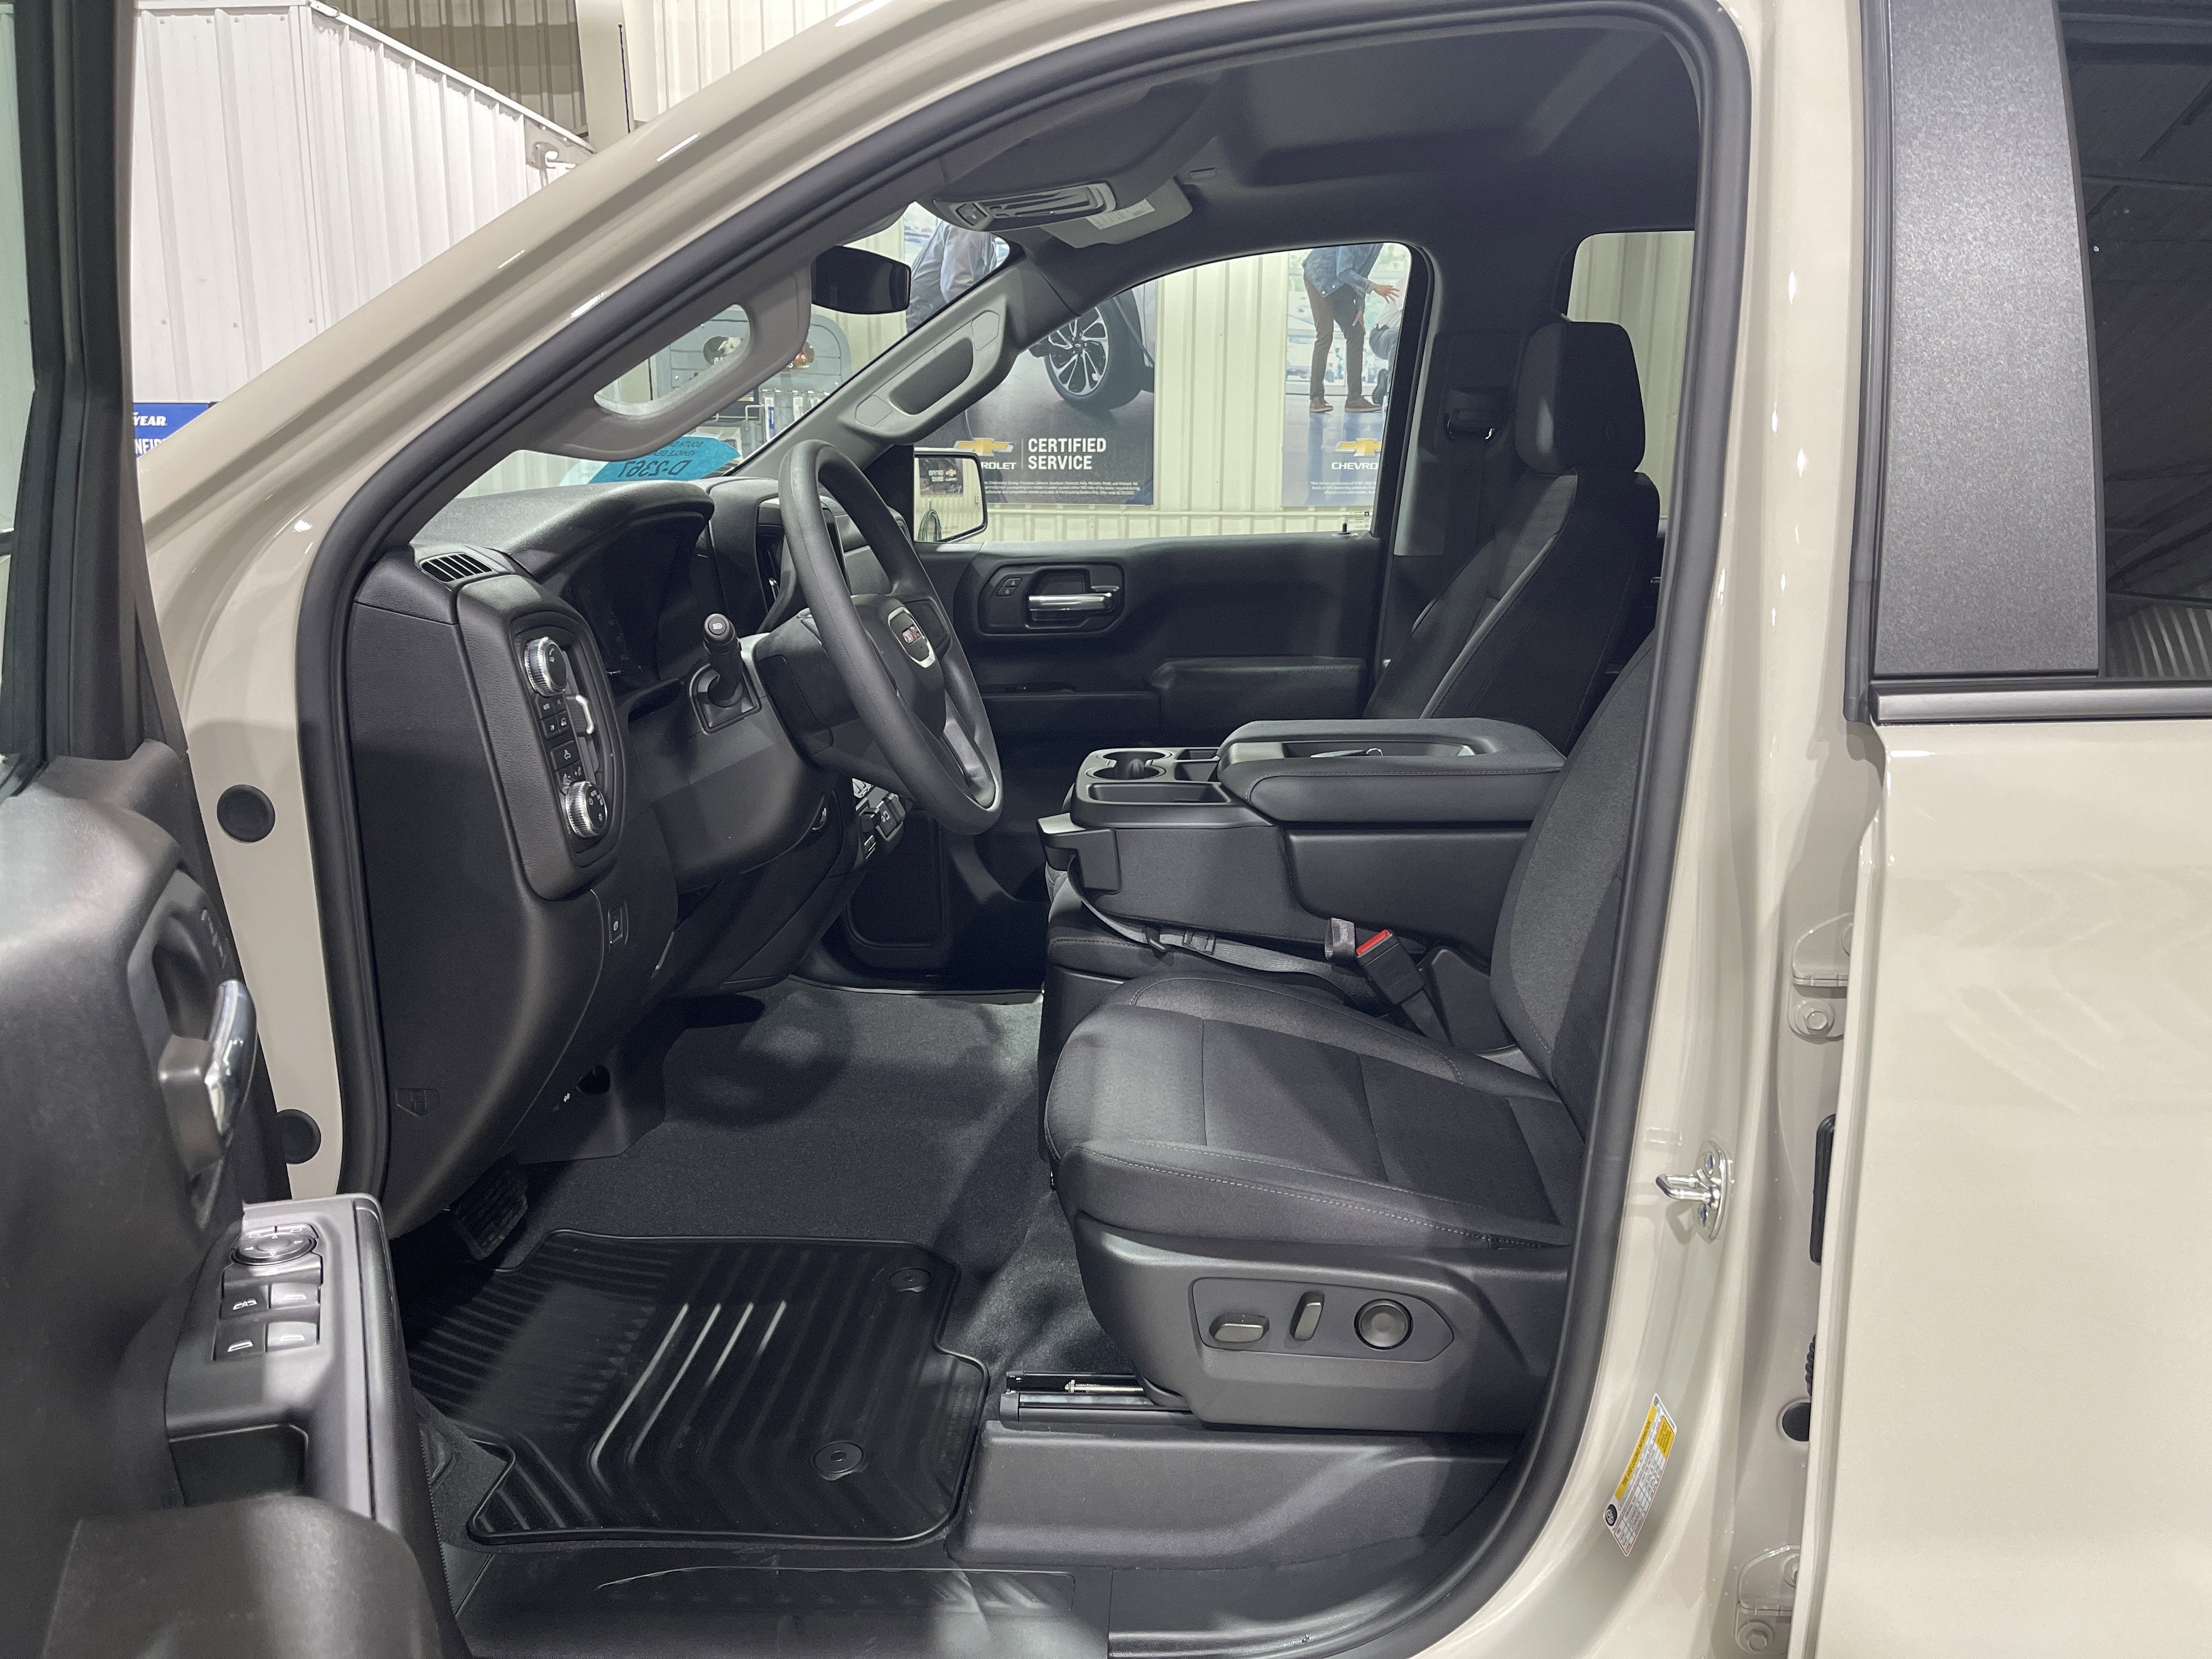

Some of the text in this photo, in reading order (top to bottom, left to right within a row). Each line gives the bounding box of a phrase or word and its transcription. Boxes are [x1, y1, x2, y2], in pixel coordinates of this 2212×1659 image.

[133, 416, 166, 426] YEAR
[1028, 438, 1107, 453] CERTIFIED
[1028, 455, 1092, 470] SERVICE
